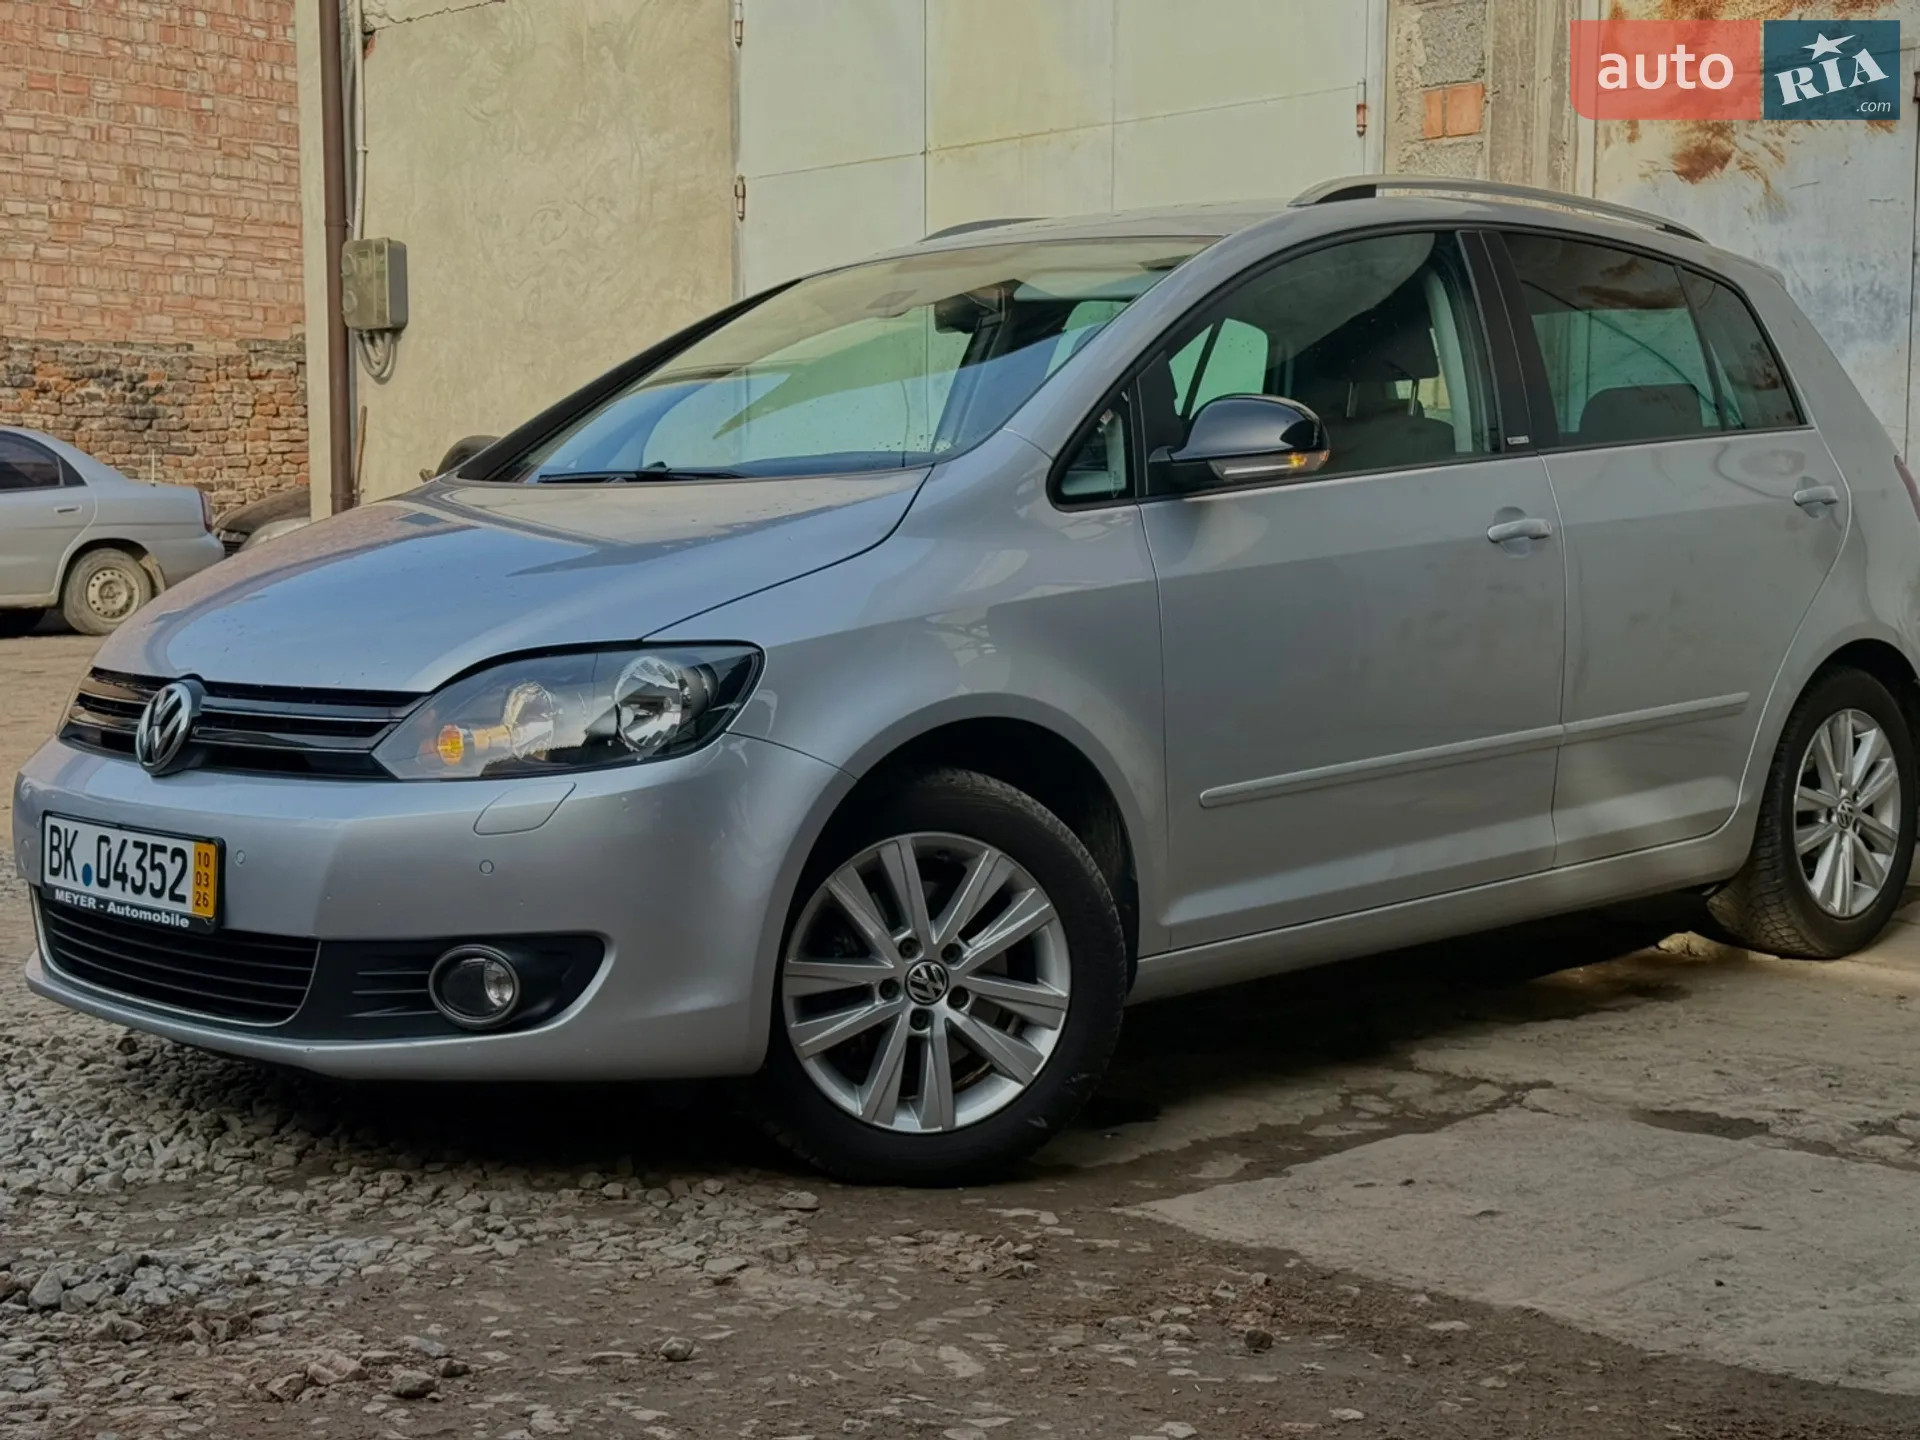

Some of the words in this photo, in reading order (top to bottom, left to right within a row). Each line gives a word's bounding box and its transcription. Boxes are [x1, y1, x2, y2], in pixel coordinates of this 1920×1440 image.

[49, 824, 79, 882] BK
[96, 835, 188, 904] 04352
[197, 851, 210, 868] 10
[195, 871, 210, 887] 03
[54, 888, 97, 910] MEYER
[106, 902, 190, 928] Automobile
[195, 891, 209, 908] 26
